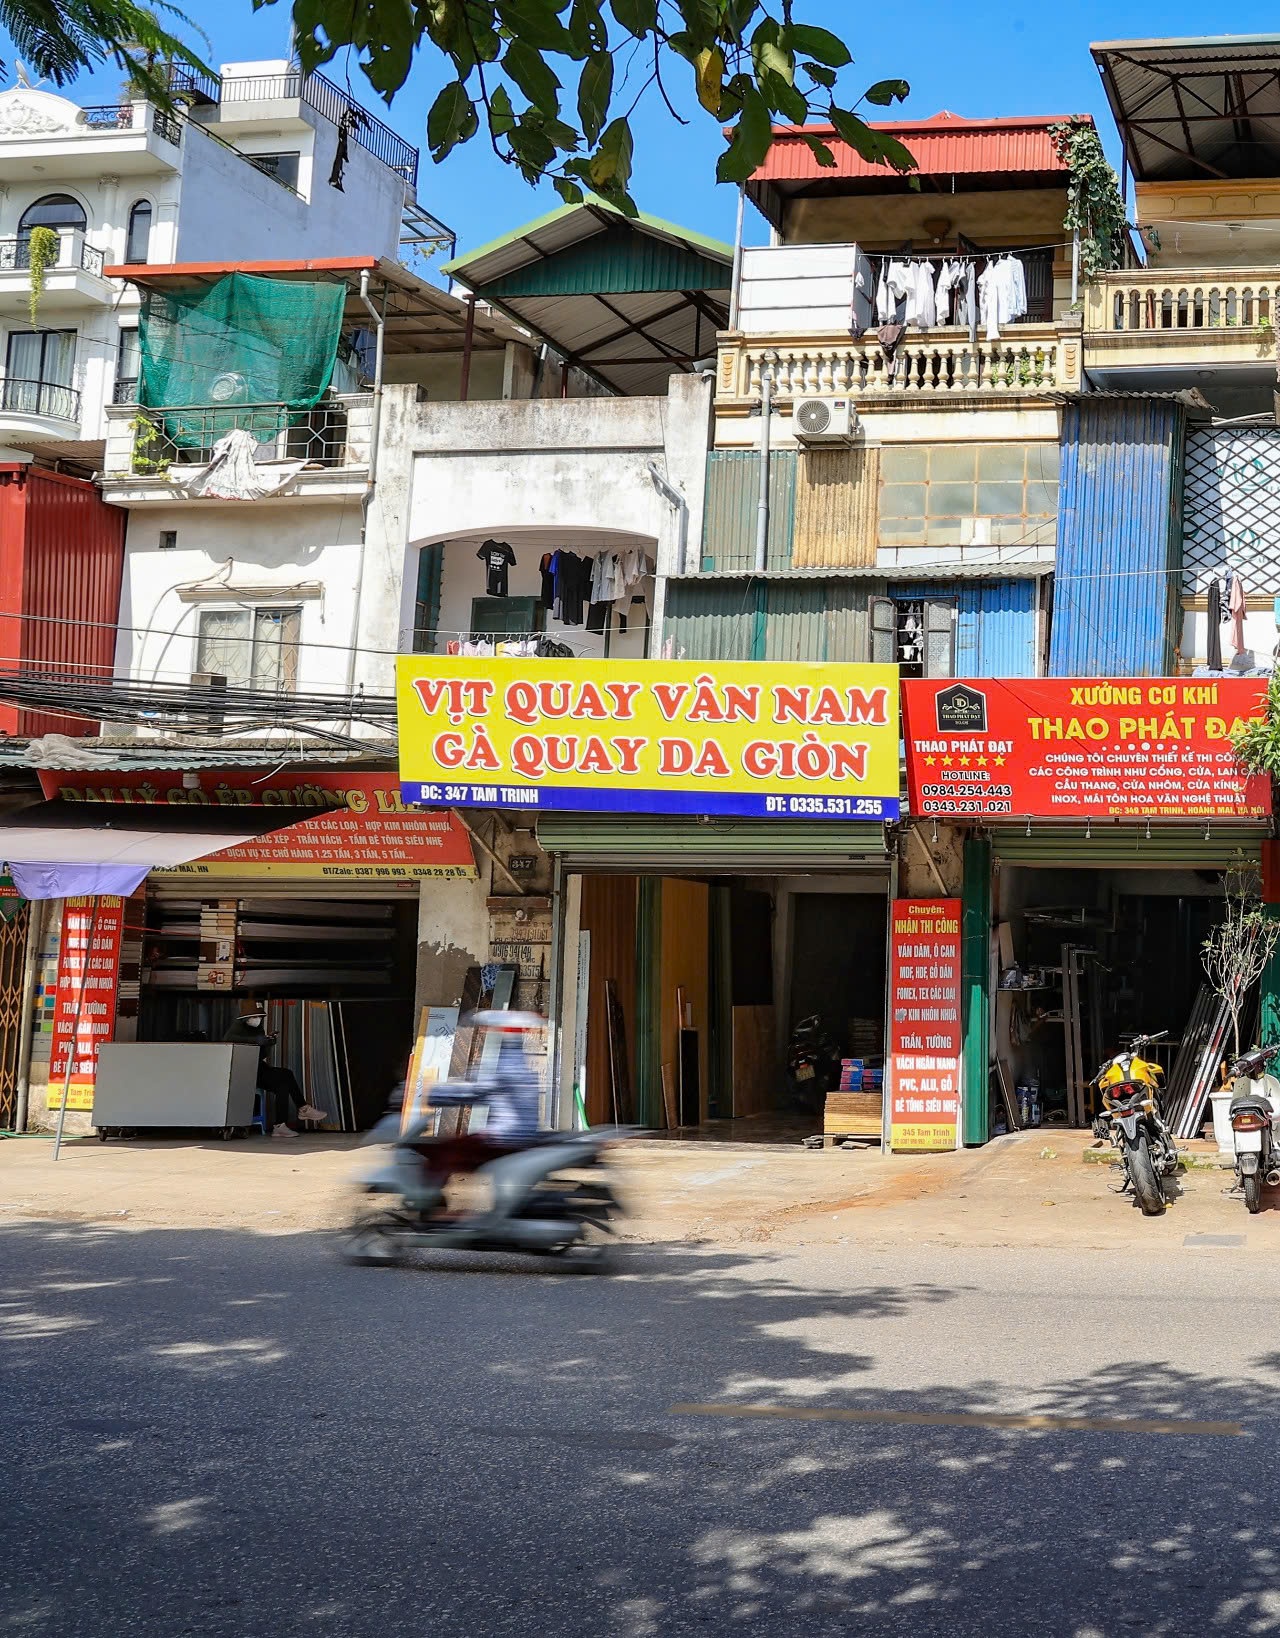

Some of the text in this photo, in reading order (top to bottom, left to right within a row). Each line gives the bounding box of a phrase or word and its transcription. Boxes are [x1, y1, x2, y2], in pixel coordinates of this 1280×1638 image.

[412, 674, 889, 726] VỊT QUAY VÂN NAM
[1070, 681, 1218, 705] XƯỞNG CƠ KHÍ
[1027, 710, 1196, 740] THAO PHÁT
[433, 723, 870, 781] GÀ QUAY DA GIÒN
[914, 738, 1014, 755] THAO PHÁT ĐẠT
[1045, 750, 1213, 763] CHÚNG TÔI CHUYÊN THIẾT KẾ THI
[941, 771, 990, 780] HOTLINE:
[1029, 765, 1053, 777] CÁC
[1056, 765, 1089, 777] CÔNG
[1092, 765, 1121, 777] TRÌNH
[1124, 766, 1147, 777] NHƯ
[1217, 767, 1238, 777] LAN
[922, 785, 1012, 796] 0984.254.443
[1055, 777, 1078, 790] CẦU
[1080, 781, 1120, 791] THANG,
[1122, 778, 1147, 790] CỬA
[1149, 779, 1185, 791] NHÔM,
[1187, 778, 1211, 790] CỬA
[421, 784, 882, 815] ĐC: 347 TAM TRINH ĐT: 0335.531.255
[923, 800, 1012, 812] 0343.231.021
[1051, 794, 1081, 805] INOX,
[1084, 793, 1104, 804] MÁI
[1106, 793, 1127, 804] TÔN
[1130, 794, 1155, 804] HOA
[1156, 793, 1180, 804] VĂN
[1141, 806, 1157, 815] TAM
[1159, 806, 1186, 816] TRINH,
[1217, 806, 1236, 816] MAI,
[303, 820, 320, 830] TEX
[321, 819, 338, 830] CÁC
[340, 820, 359, 832] LOẠI
[384, 821, 401, 831] KIM
[402, 820, 428, 831] NHÔM
[320, 834, 342, 845] VÁCH
[381, 835, 404, 846] TÔNG
[405, 835, 425, 846] SIÊU
[260, 849, 271, 858] XE
[291, 847, 313, 859] HÀNG
[314, 850, 333, 859] 1.25
[354, 850, 360, 859] 3
[382, 850, 388, 859] 5
[198, 865, 209, 873] HN
[355, 867, 373, 875] 0387
[391, 868, 406, 876] 993
[413, 868, 433, 876] 0348
[433, 868, 444, 876] 28
[445, 868, 455, 877] 28
[511, 860, 533, 869] 347
[908, 905, 945, 915] Chuyên:
[895, 916, 959, 937] NHẬN THI CÔNG
[897, 942, 956, 958] VÁN CAN
[899, 963, 953, 980] MDF, HDF, DÁN
[896, 987, 918, 1001] FOMEX,
[918, 987, 930, 1000] TEX
[930, 984, 942, 1000] CÁC
[908, 1007, 920, 1021] KIM
[921, 1006, 940, 1021] NHÔM
[926, 1032, 952, 1049] TƯỜNG
[896, 1055, 957, 1070] VÁCH NANO
[899, 1078, 939, 1093] PVC, ALU,
[905, 1097, 925, 1113] TÔNG
[902, 1128, 950, 1137] 345 Tam Trinh
